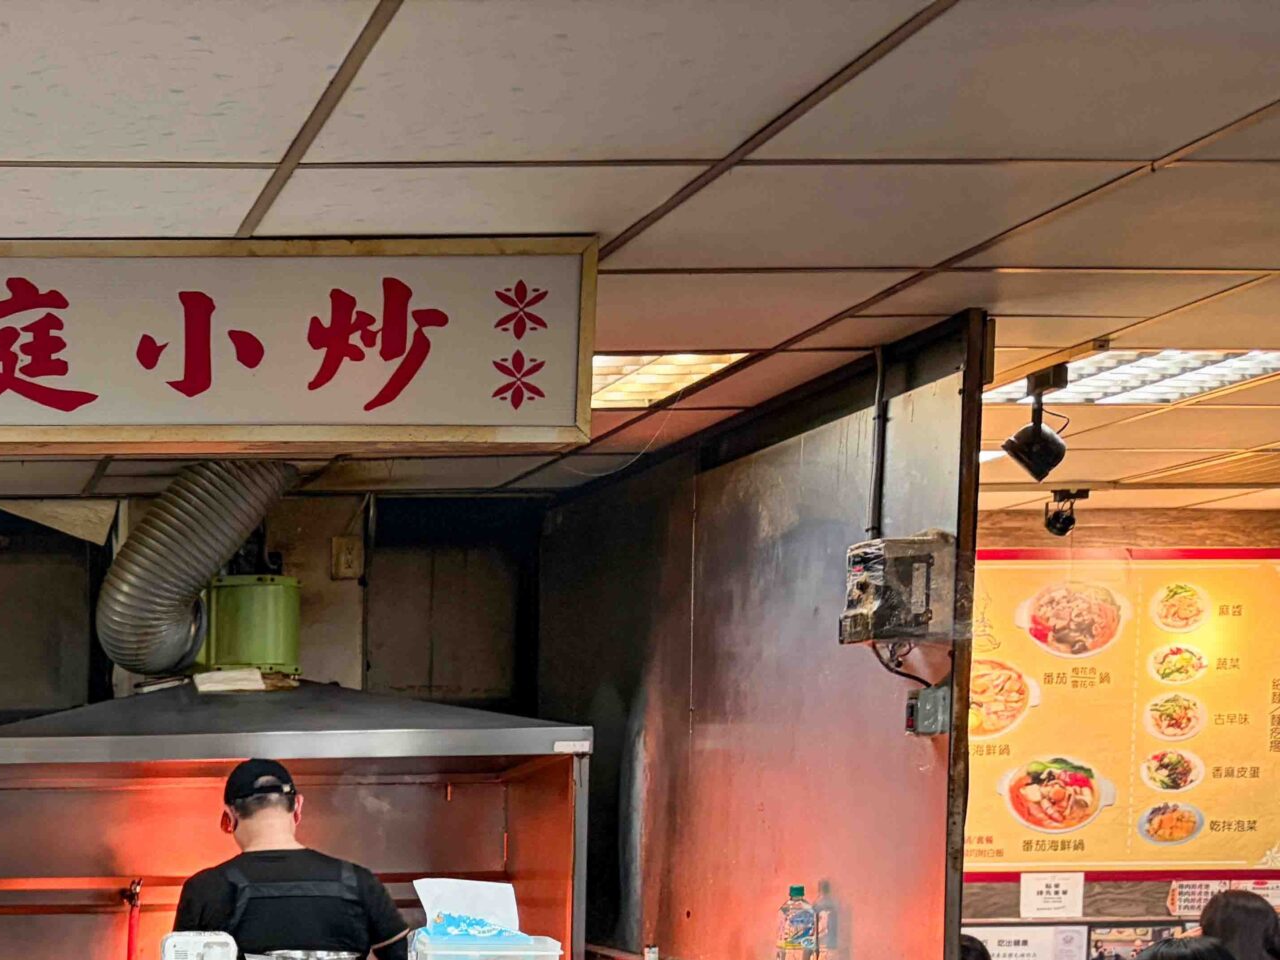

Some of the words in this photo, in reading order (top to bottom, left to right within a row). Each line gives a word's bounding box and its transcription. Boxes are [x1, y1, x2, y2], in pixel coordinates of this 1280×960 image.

[1216, 658, 1240, 670] 蔬菜
[1043, 672, 1067, 685] 番茄
[1214, 712, 1250, 726] 古早味
[1209, 820, 1258, 833] 乾拌泡菜
[1022, 839, 1085, 852] 番茄海鮮鍋
